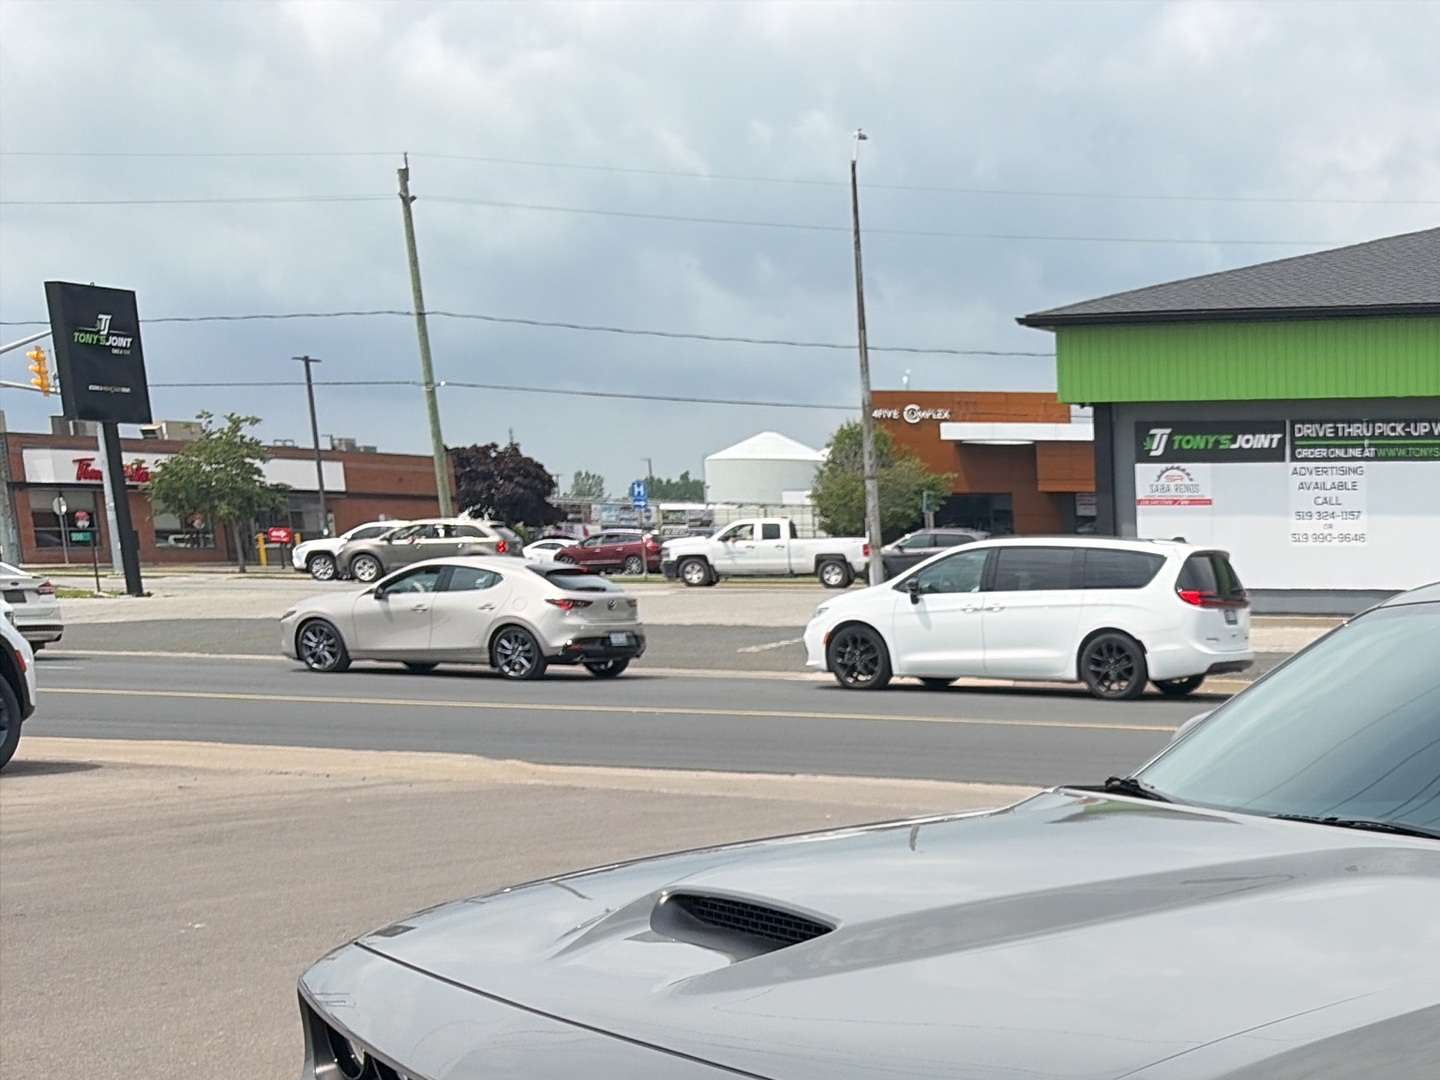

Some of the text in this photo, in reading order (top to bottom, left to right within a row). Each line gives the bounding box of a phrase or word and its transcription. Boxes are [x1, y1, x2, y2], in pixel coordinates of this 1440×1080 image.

[105, 335, 133, 348] JOINT
[1294, 423, 1335, 437] DRIVE
[1335, 422, 1373, 436] THRU
[1374, 422, 1431, 436] PICK-UP
[1229, 434, 1283, 449] JOINT
[1295, 448, 1328, 458] ORDER
[1328, 448, 1363, 458] ONLINE
[1362, 447, 1376, 457] AT
[1291, 466, 1364, 476] ADVERTISING
[633, 484, 645, 496] H
[1298, 481, 1358, 491] AVAILABLE
[1313, 496, 1342, 505] CALL
[1295, 511, 1313, 520] 519
[1291, 533, 1309, 543] 519
